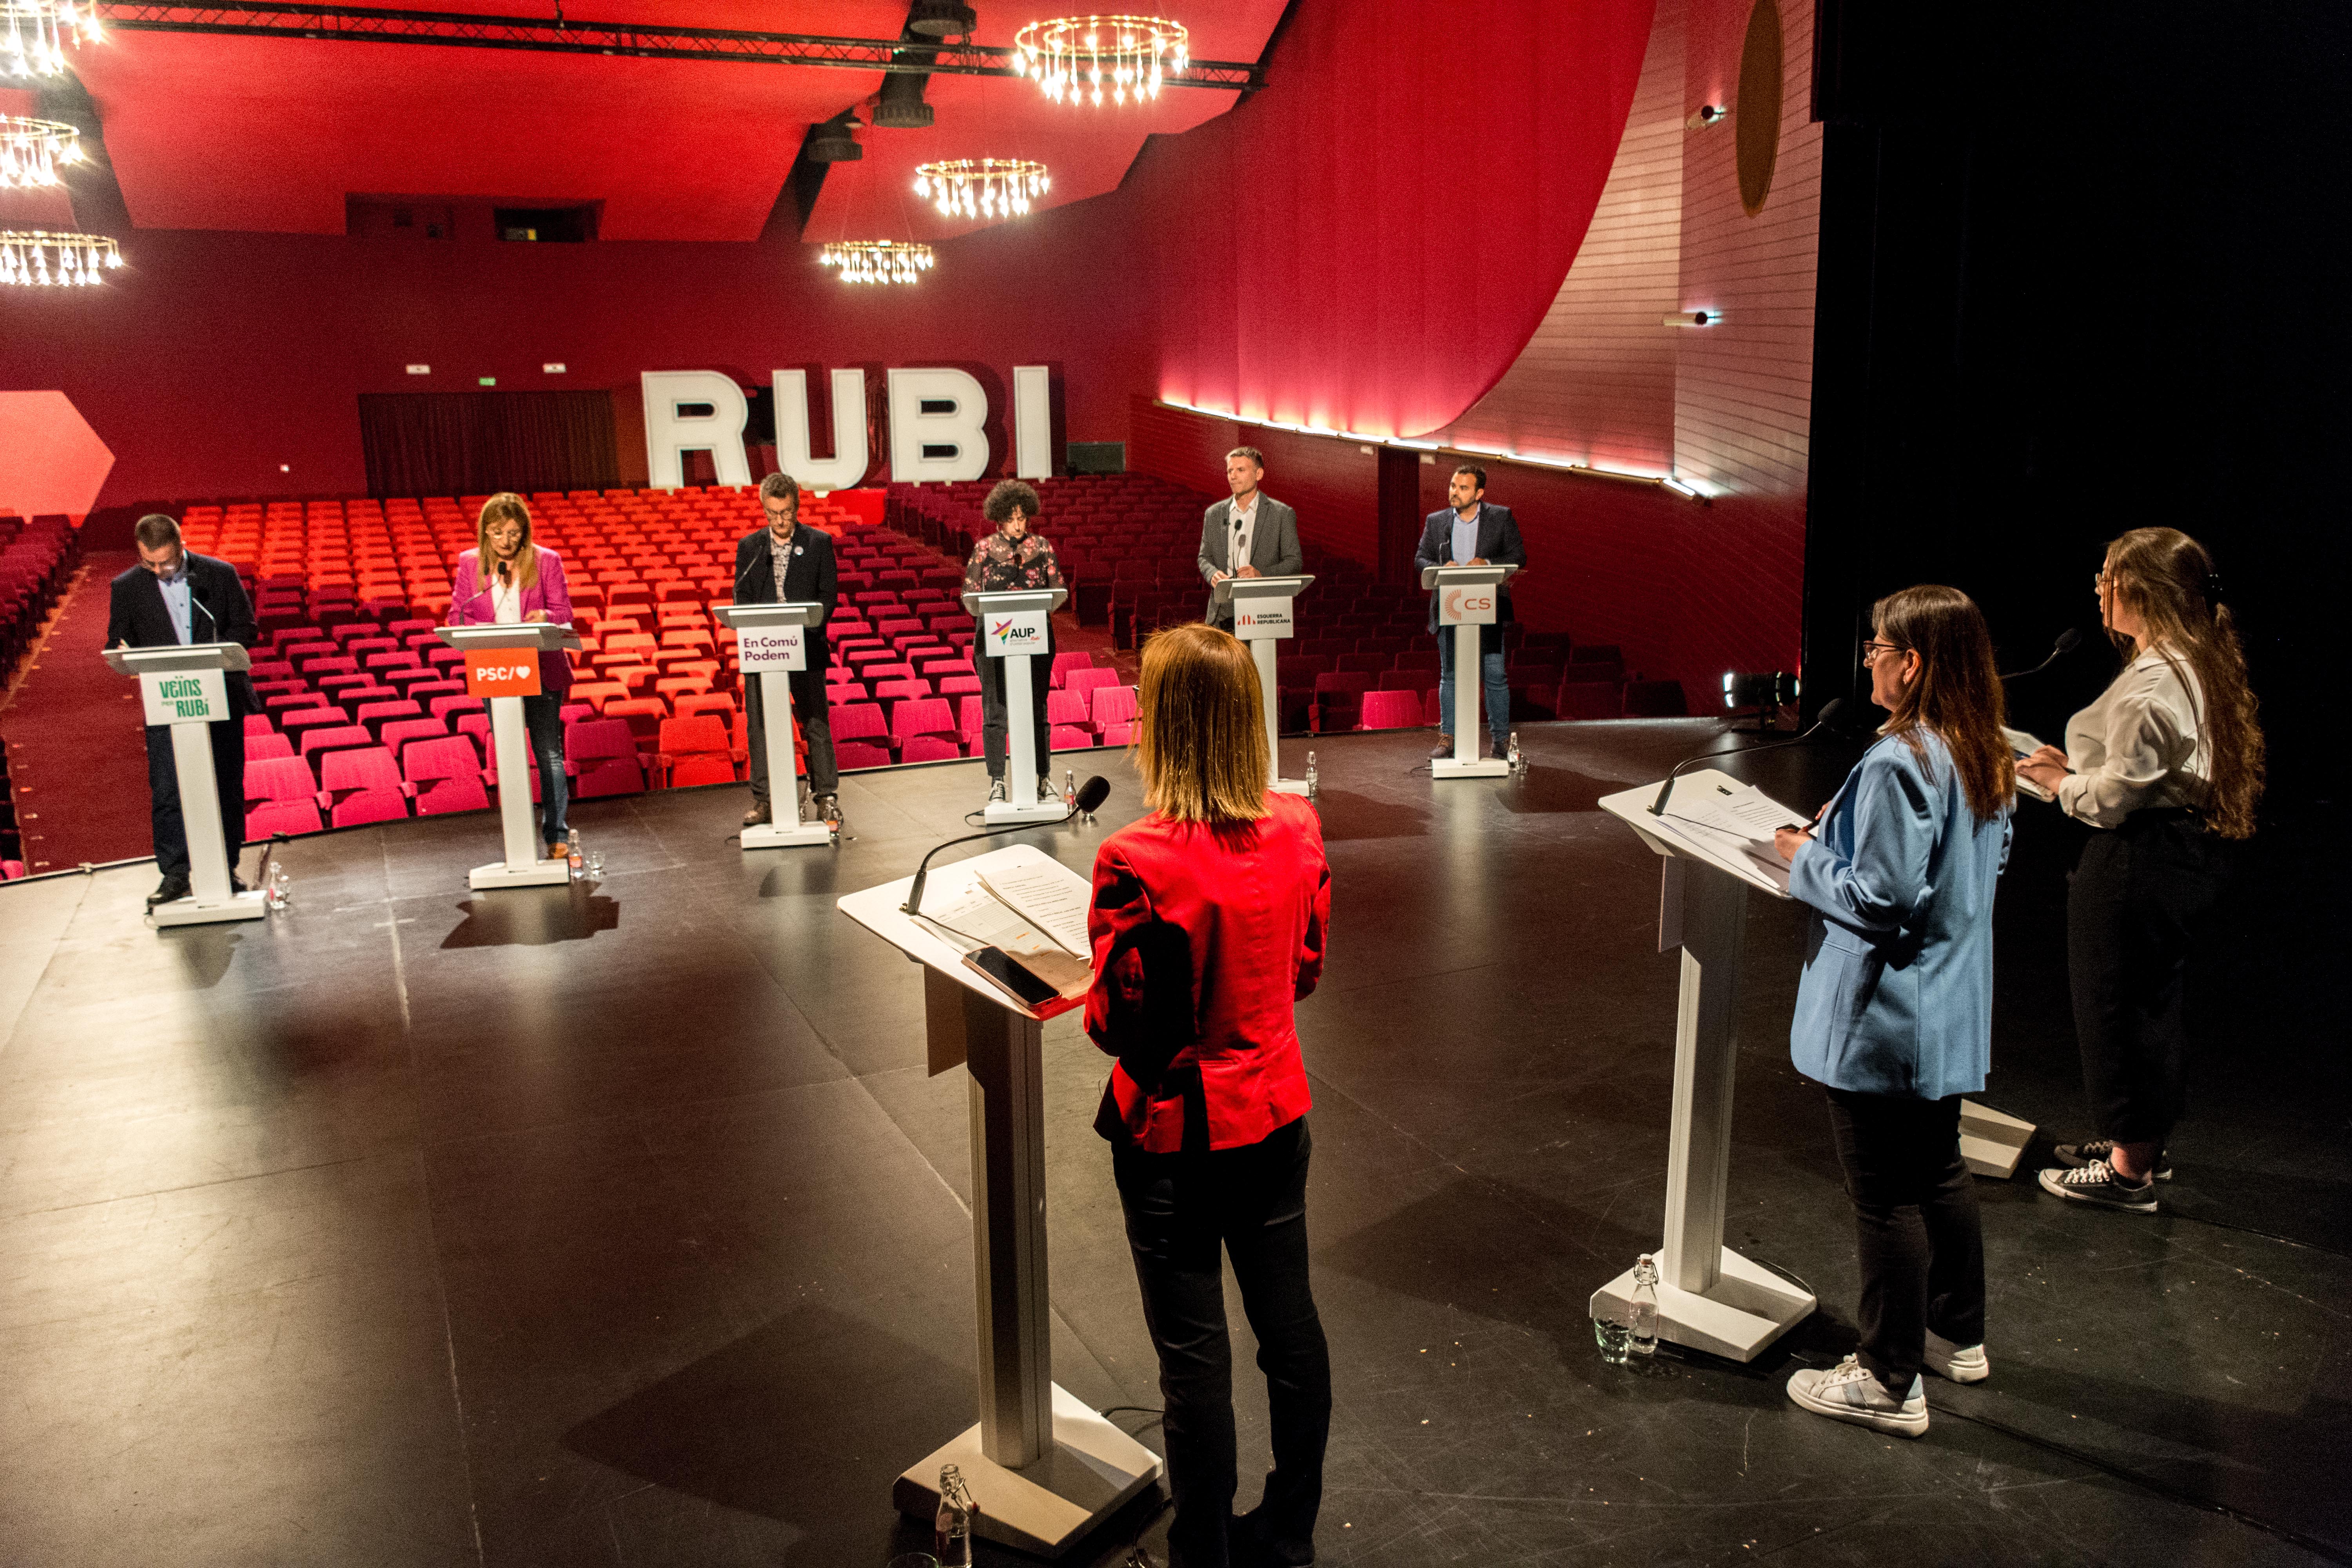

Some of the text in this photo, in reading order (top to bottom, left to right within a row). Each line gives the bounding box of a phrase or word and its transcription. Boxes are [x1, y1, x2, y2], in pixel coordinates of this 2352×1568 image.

[641, 365, 1052, 490] RUBI
[1465, 598, 1491, 610] CS
[1010, 628, 1035, 638] AUP
[744, 635, 798, 648] En Comú
[745, 650, 790, 661] Podem
